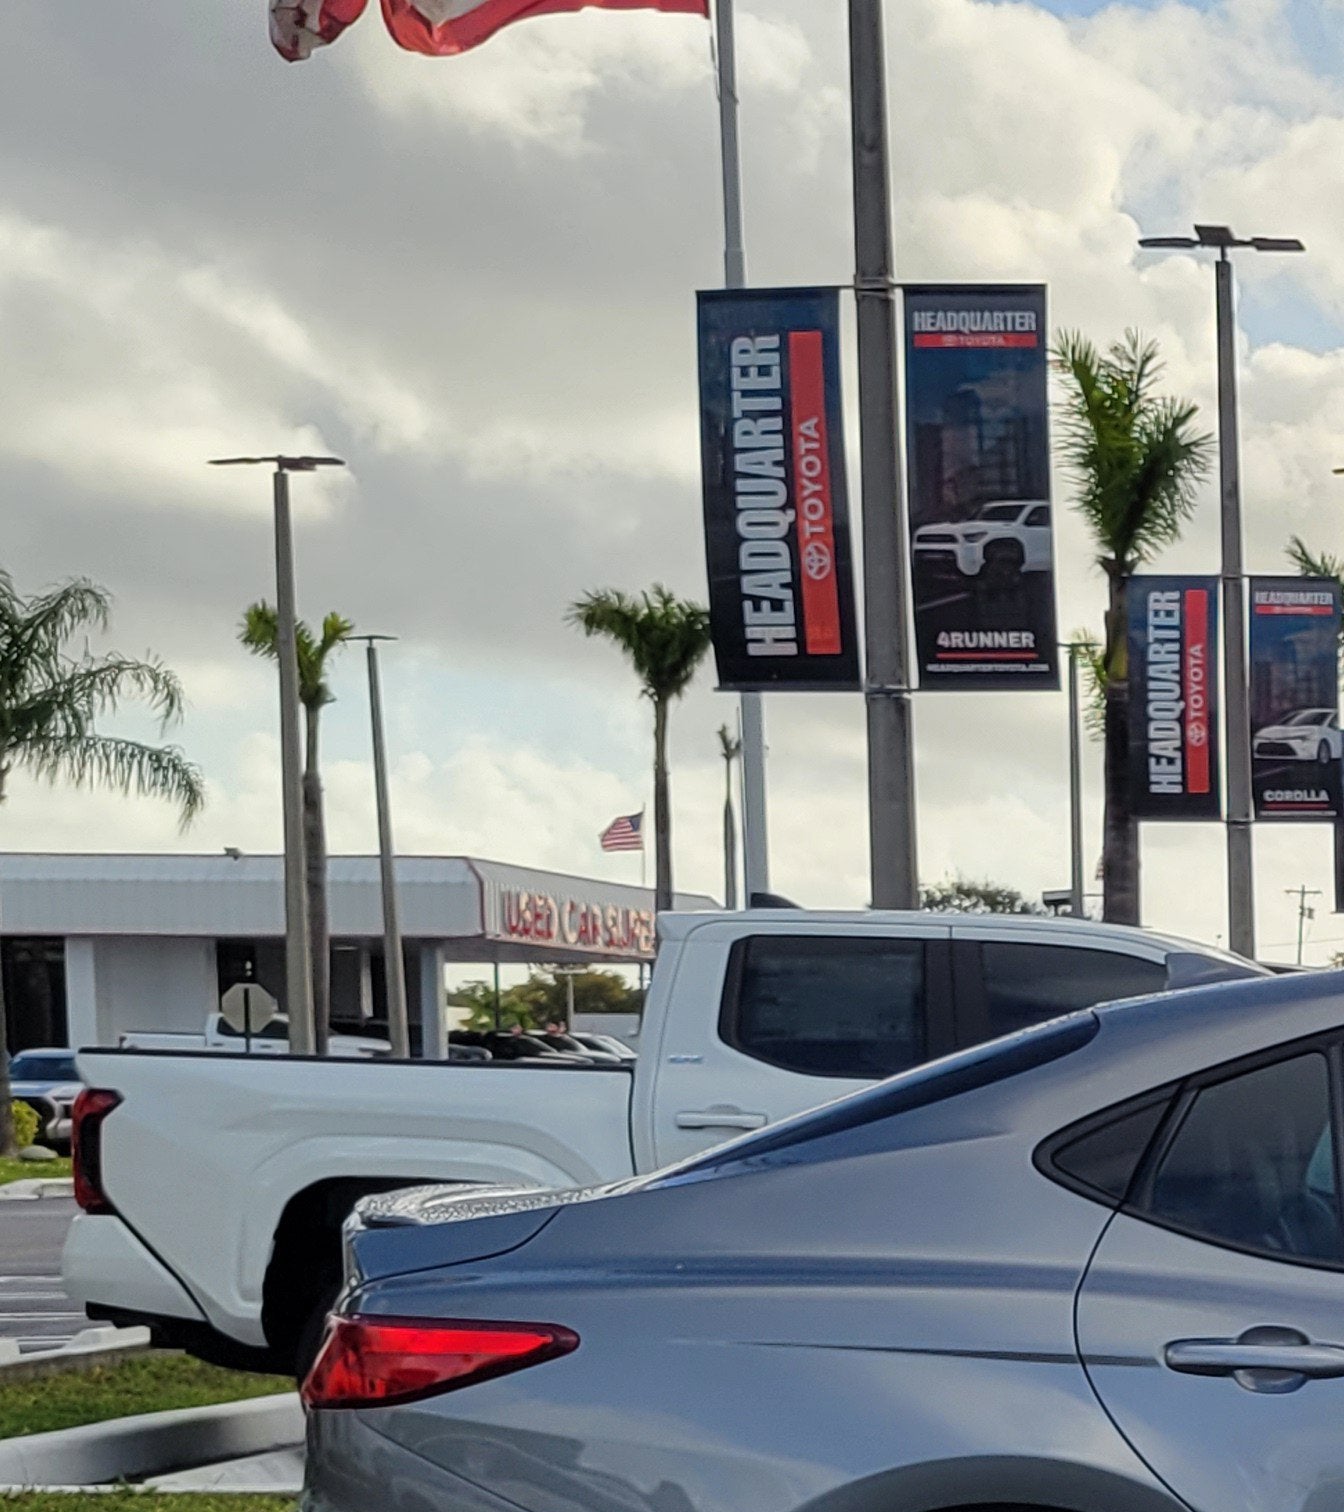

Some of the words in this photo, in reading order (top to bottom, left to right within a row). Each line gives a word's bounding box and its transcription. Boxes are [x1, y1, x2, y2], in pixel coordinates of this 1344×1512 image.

[913, 310, 1037, 334] HEADQUARTER
[730, 332, 799, 656] HEADQUARTER
[800, 416, 827, 538] TOYOTA
[936, 631, 1036, 648] 4RUNNER
[1147, 590, 1186, 794] HEADQUARTER
[1189, 644, 1204, 719] TOYOTA
[1263, 789, 1331, 802] COROLLA
[505, 890, 558, 940] USED
[561, 899, 602, 949] CAR
